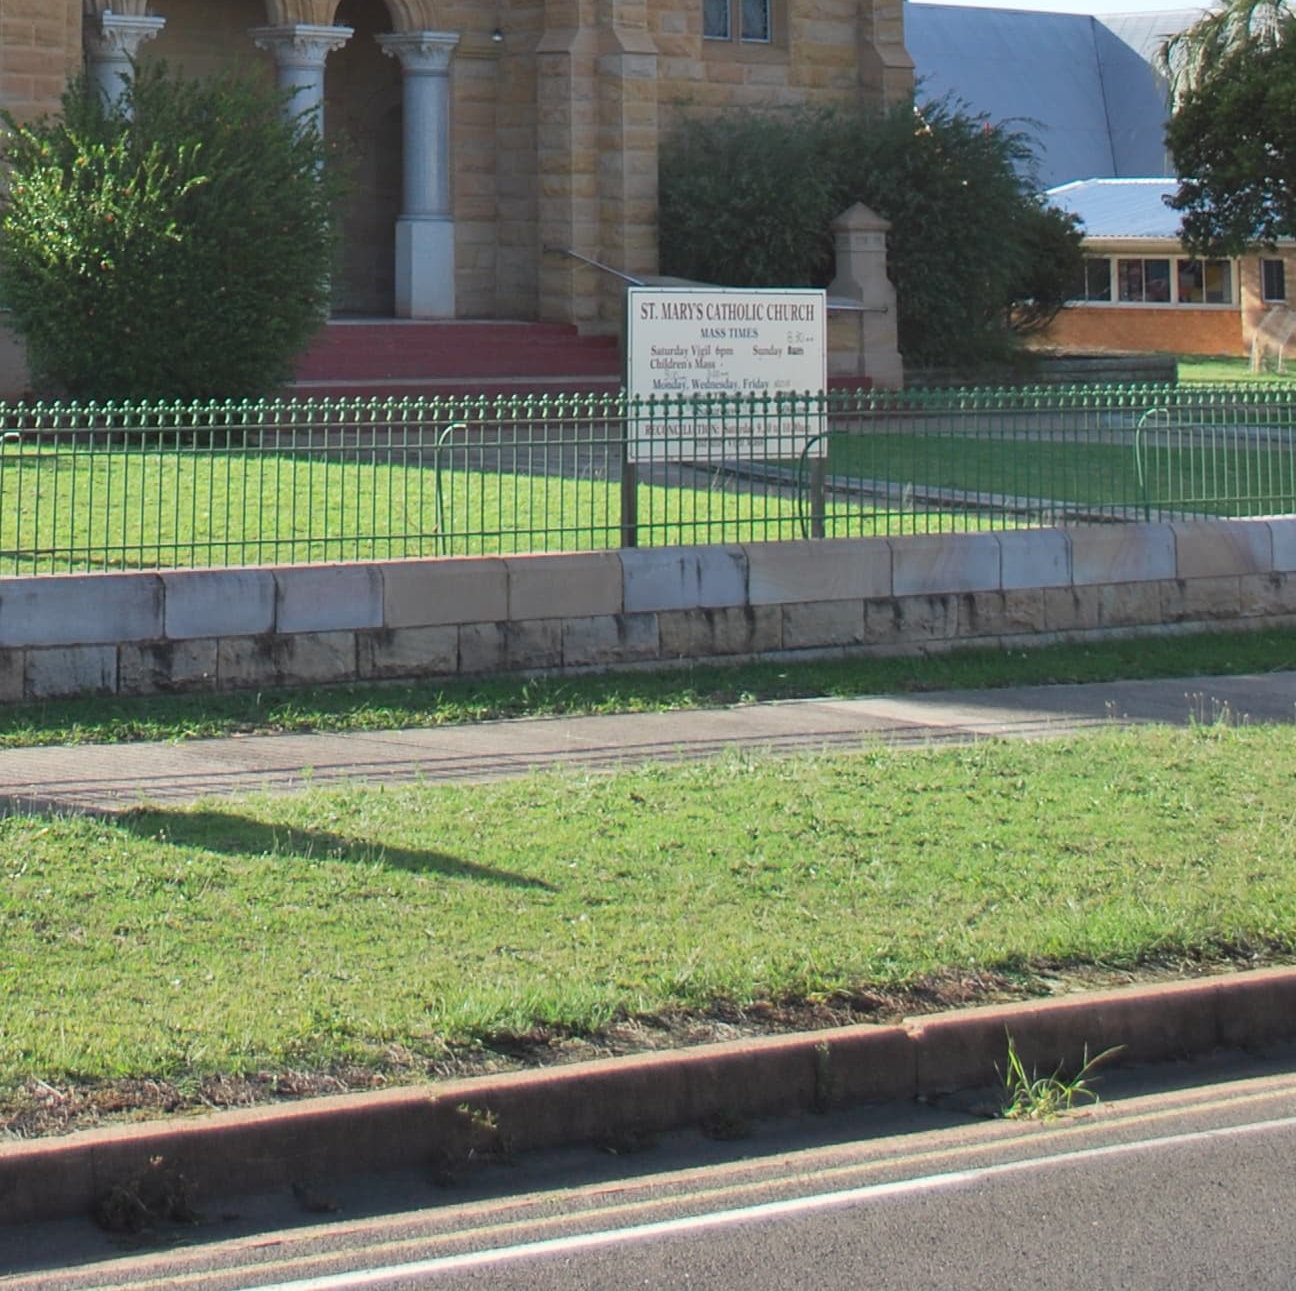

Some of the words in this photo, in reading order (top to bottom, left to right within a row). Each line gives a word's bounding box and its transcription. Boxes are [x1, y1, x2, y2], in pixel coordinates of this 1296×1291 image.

[640, 302, 658, 320] ST.
[662, 302, 704, 321] MARY'S
[706, 303, 764, 321] CATHOLIC
[766, 303, 815, 322] CHURCH
[700, 327, 726, 339] MASS
[729, 327, 759, 339] TIMES
[650, 344, 688, 358] Saturday
[691, 344, 711, 358] Vigil
[715, 344, 734, 358] 6pm
[752, 344, 783, 358] Sunday
[649, 357, 692, 369] Children's
[694, 357, 716, 369] Mass
[742, 377, 769, 391] Friday
